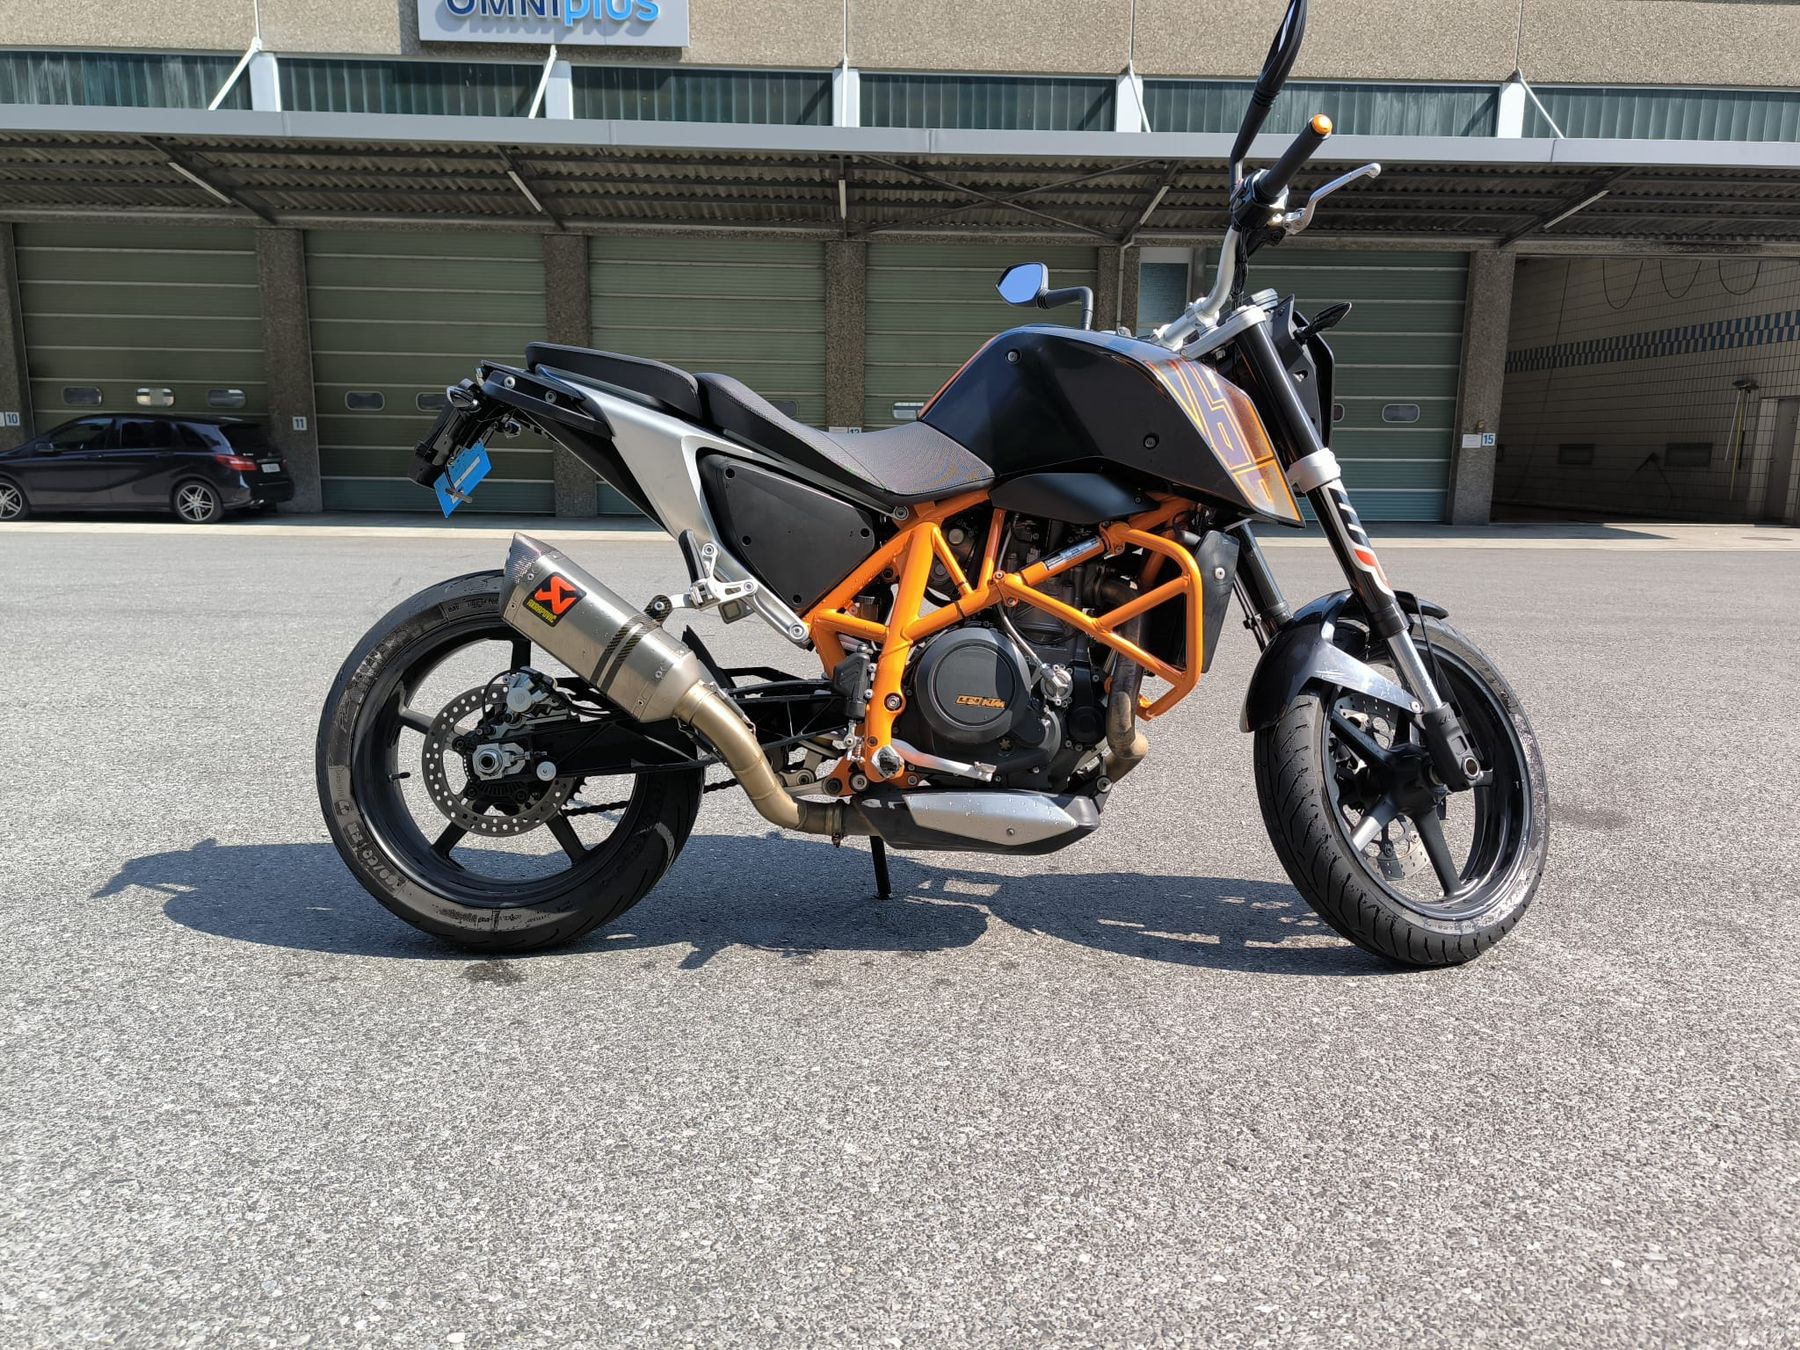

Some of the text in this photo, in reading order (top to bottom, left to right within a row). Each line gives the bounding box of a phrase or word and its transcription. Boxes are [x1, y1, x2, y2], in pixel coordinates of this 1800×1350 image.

[7, 414, 18, 424] 10
[295, 418, 304, 428] 11
[1484, 434, 1494, 445] 15
